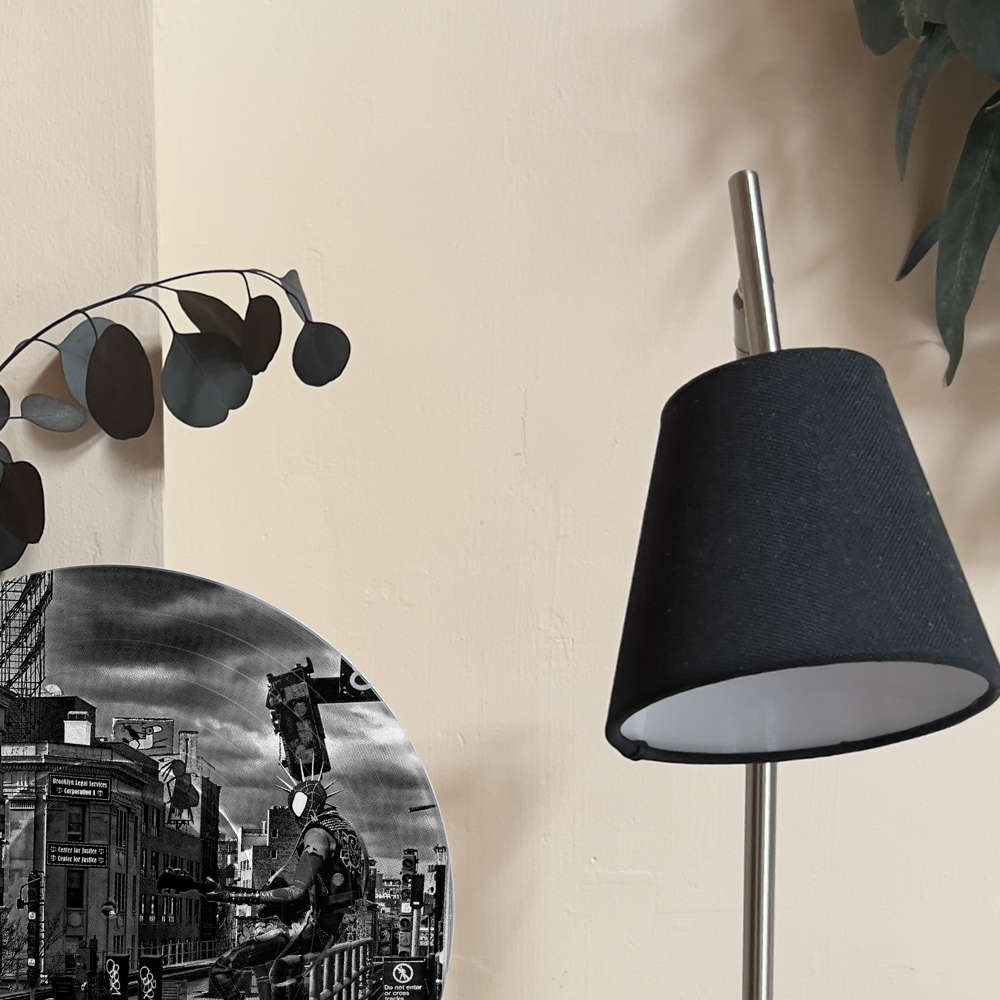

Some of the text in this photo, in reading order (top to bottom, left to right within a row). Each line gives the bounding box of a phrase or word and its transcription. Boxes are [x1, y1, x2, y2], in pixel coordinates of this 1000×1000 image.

[52, 777, 108, 788] Brooklyn Legal Services
[63, 787, 92, 795] Corporation
[57, 846, 98, 855] Center for Justice
[57, 855, 73, 863] Center
[81, 856, 98, 864] Justice
